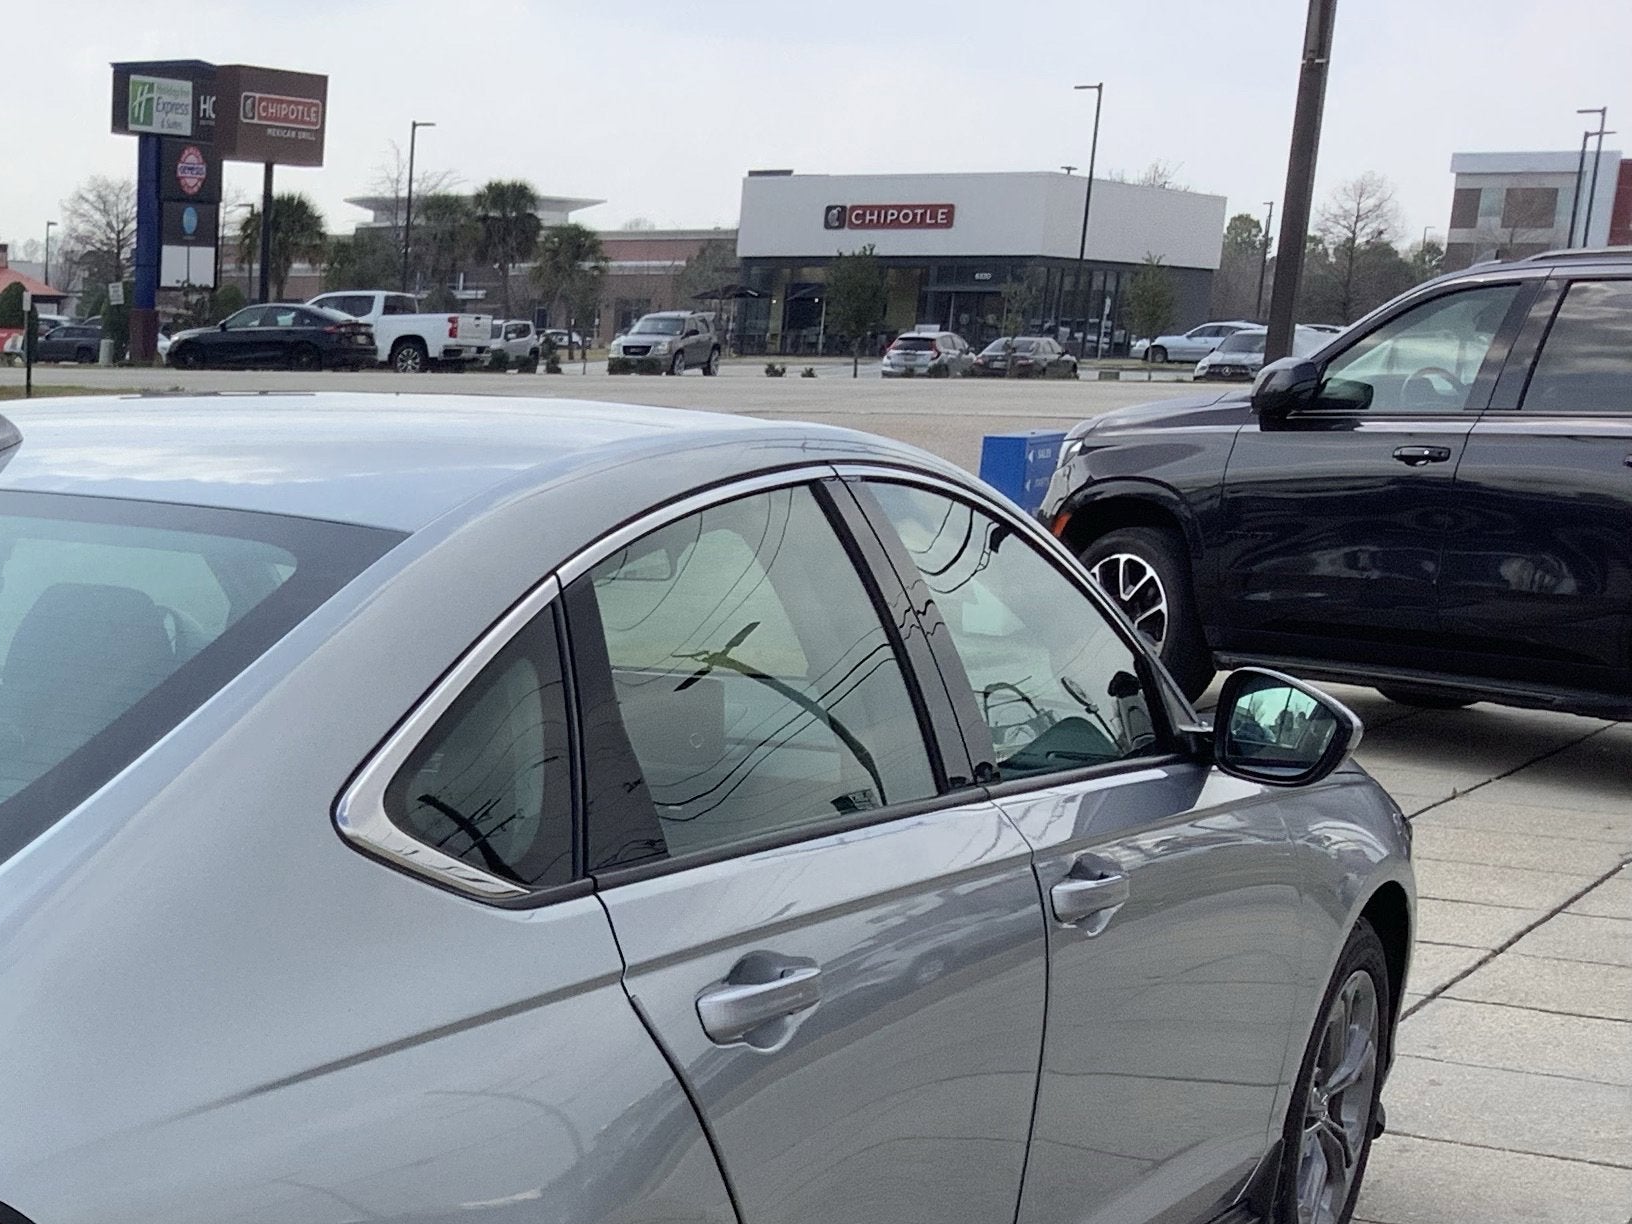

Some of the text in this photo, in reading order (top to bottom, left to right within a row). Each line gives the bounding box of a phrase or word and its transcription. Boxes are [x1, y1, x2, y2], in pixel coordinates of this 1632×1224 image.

[156, 96, 189, 117] Express
[259, 101, 318, 122] CHIPOTLE
[851, 208, 949, 224] CHIPOTLE
